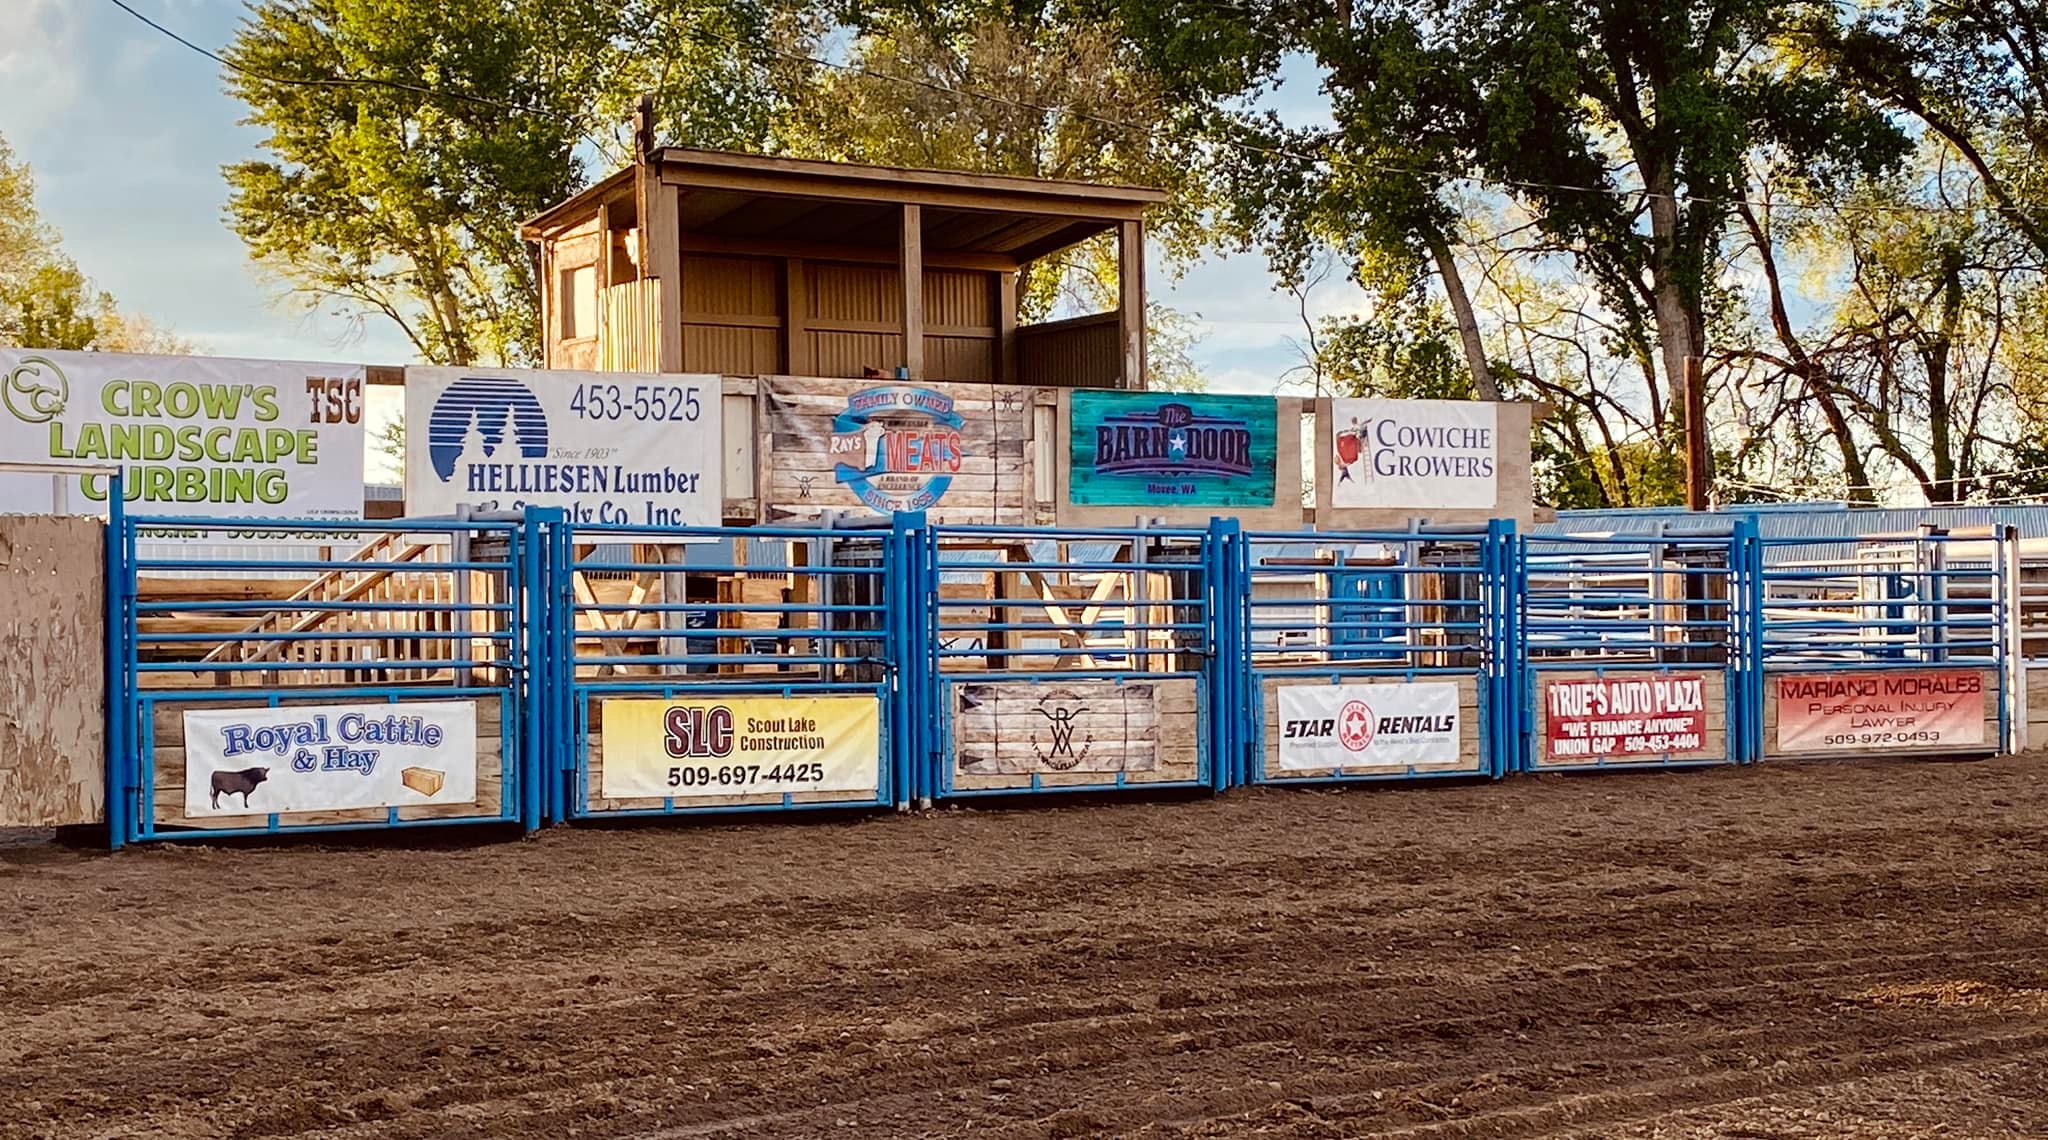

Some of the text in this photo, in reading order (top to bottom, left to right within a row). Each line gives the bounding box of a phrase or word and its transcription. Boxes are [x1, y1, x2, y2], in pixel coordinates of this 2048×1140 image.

[101, 380, 280, 421] CROW'S
[306, 376, 361, 424] TSC
[570, 384, 701, 422] 453-5525
[853, 392, 950, 413] FAMILY OWNED
[1164, 408, 1187, 424] The
[49, 422, 318, 465] LANDSCAPE
[830, 435, 862, 454] RAY'S
[1095, 425, 1252, 467] BARN DOOR
[1376, 419, 1491, 449] COWICHE
[885, 431, 963, 473] MEATS
[1374, 449, 1493, 478] GROWERS
[80, 466, 288, 504] CURBING
[467, 464, 700, 494] HELLIESEN Lumber
[1181, 484, 1196, 495] WA
[865, 489, 903, 512] SINCE
[646, 500, 688, 527] Inc.
[1549, 680, 1703, 717] TRUE'S AUTO PLAZA
[1781, 677, 1981, 699] MARIANO MORALES
[1808, 699, 1956, 716] PERSONAL INJURY
[222, 713, 443, 757] Royal Cattle
[665, 705, 733, 758] SLC
[747, 717, 816, 733] Scout Lake
[1284, 715, 1455, 738] STAR RENTALS
[1562, 717, 1694, 737] "WE FINANCE ANYONE"
[1851, 717, 1916, 729] LAWYER
[740, 735, 825, 751] Construction
[1554, 734, 1700, 755] UNION GAP 509-453-4404
[1824, 731, 1941, 745] 509-972-0493
[291, 745, 379, 775] & Hay
[668, 763, 824, 786] 509-697-4425
